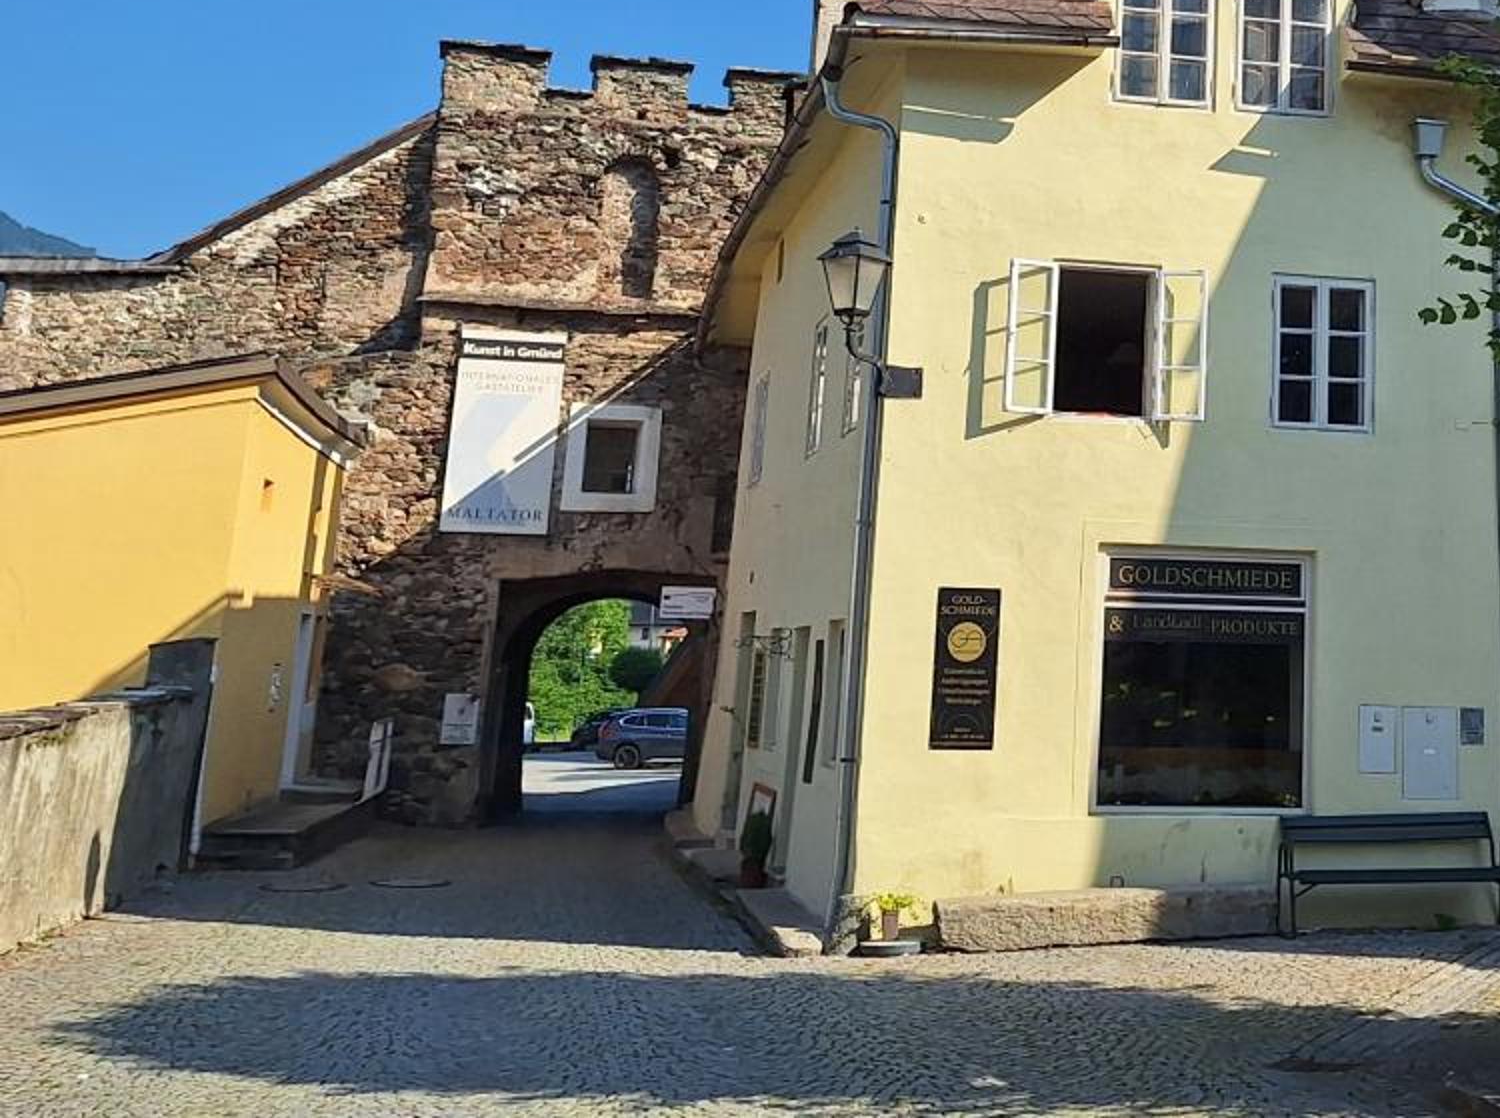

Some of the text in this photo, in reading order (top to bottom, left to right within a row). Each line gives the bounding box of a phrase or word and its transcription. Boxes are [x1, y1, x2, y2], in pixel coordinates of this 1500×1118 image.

[463, 341, 563, 359] Kunst in Gmünd
[1118, 565, 1294, 589] GOLDSCHMIEDE
[1108, 614, 1124, 633] &
[1210, 617, 1298, 636] PRODUKTE
